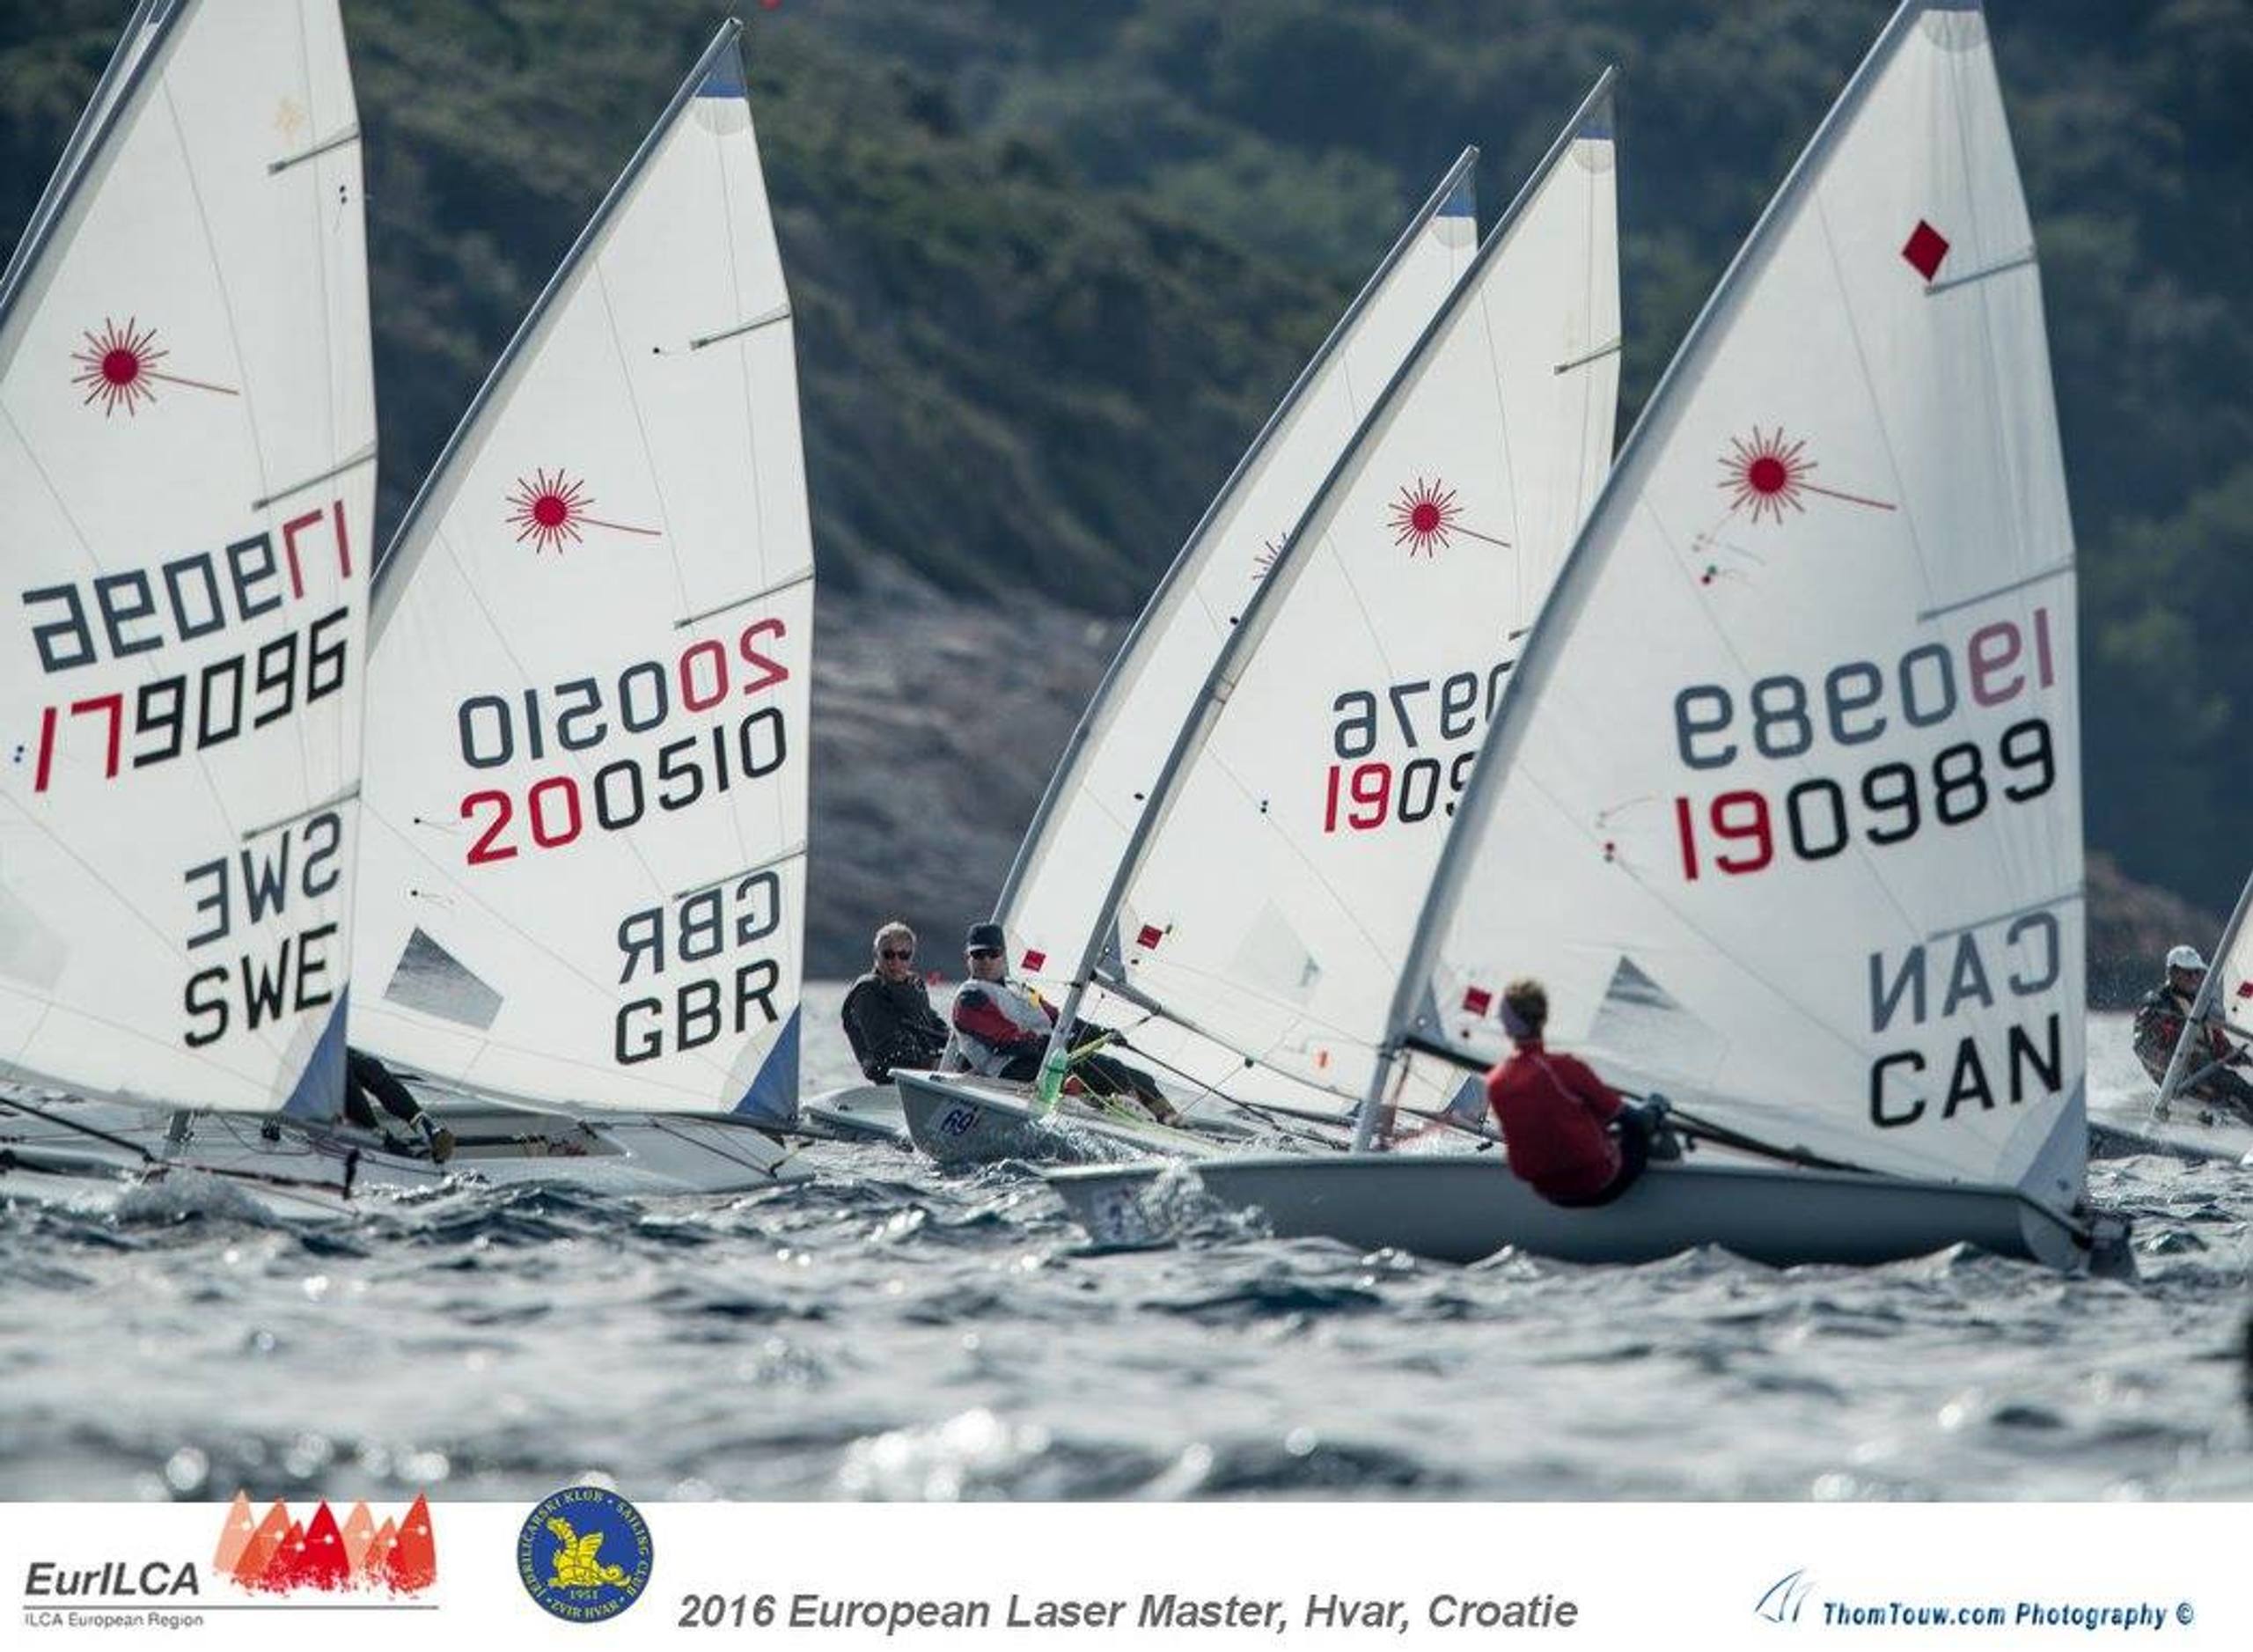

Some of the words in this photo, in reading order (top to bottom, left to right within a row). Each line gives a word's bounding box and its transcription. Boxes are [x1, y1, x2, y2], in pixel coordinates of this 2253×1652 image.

[34, 606, 349, 793] 179096
[460, 707, 787, 865] 200510
[1676, 718, 2056, 880] 190989
[184, 921, 338, 1048] SWE
[616, 958, 780, 1065] GBR
[1870, 1013, 2062, 1128] CAN
